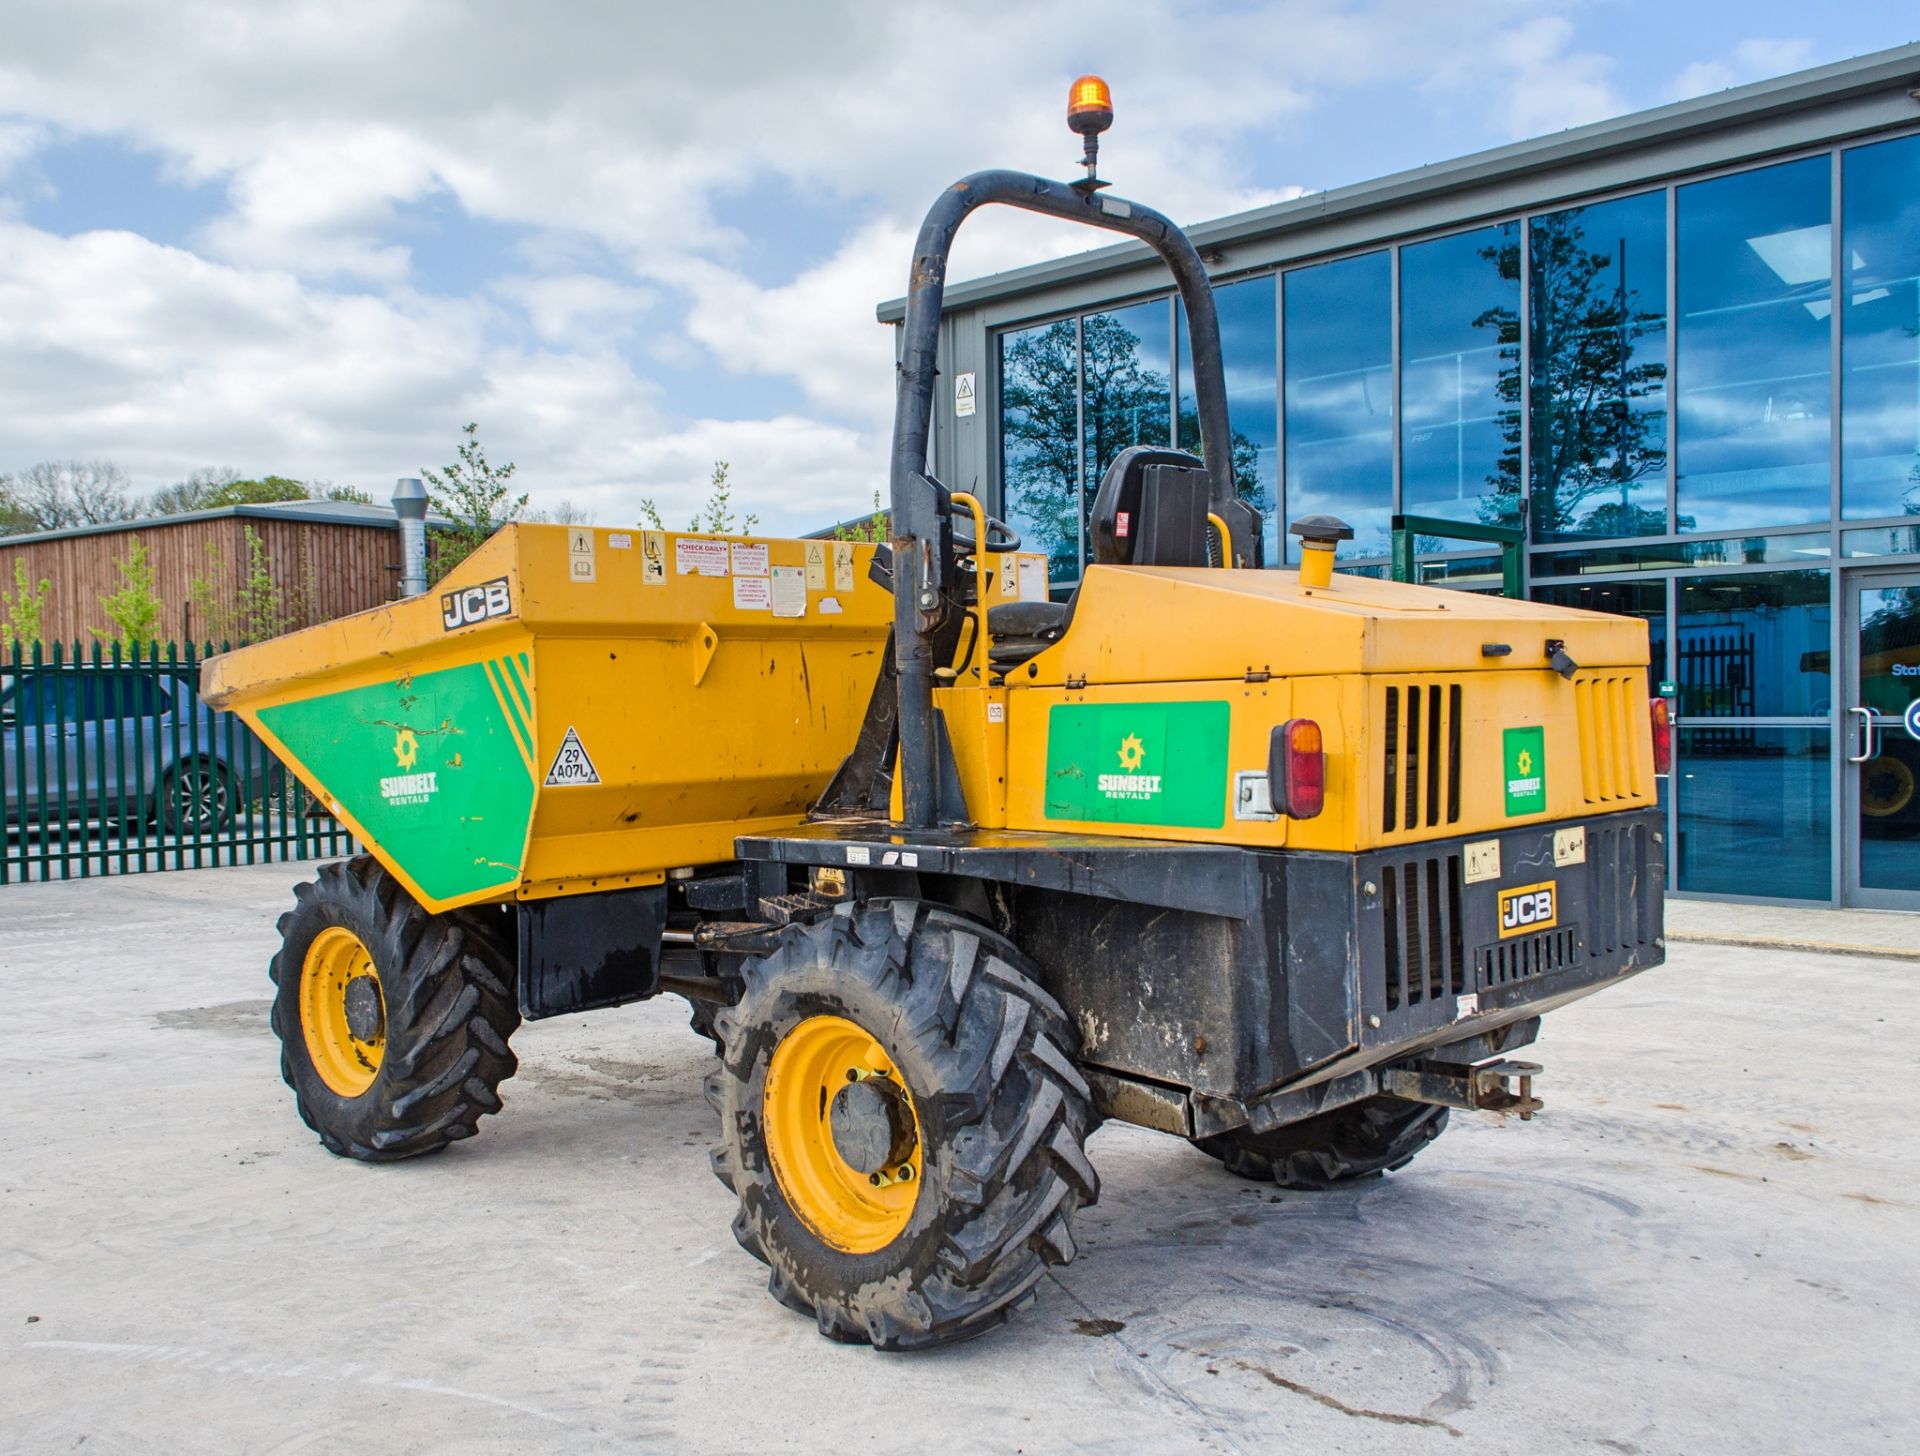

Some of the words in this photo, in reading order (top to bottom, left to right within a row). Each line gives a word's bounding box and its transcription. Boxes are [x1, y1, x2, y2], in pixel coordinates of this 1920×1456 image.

[444, 580, 510, 628] JCB
[565, 749, 580, 763] 29
[380, 772, 438, 798] SUNBELT
[1098, 774, 1161, 792] SUNBELT
[390, 794, 429, 806] RENTALS
[1105, 791, 1150, 800] RENTALS
[1503, 891, 1552, 927] JCB
